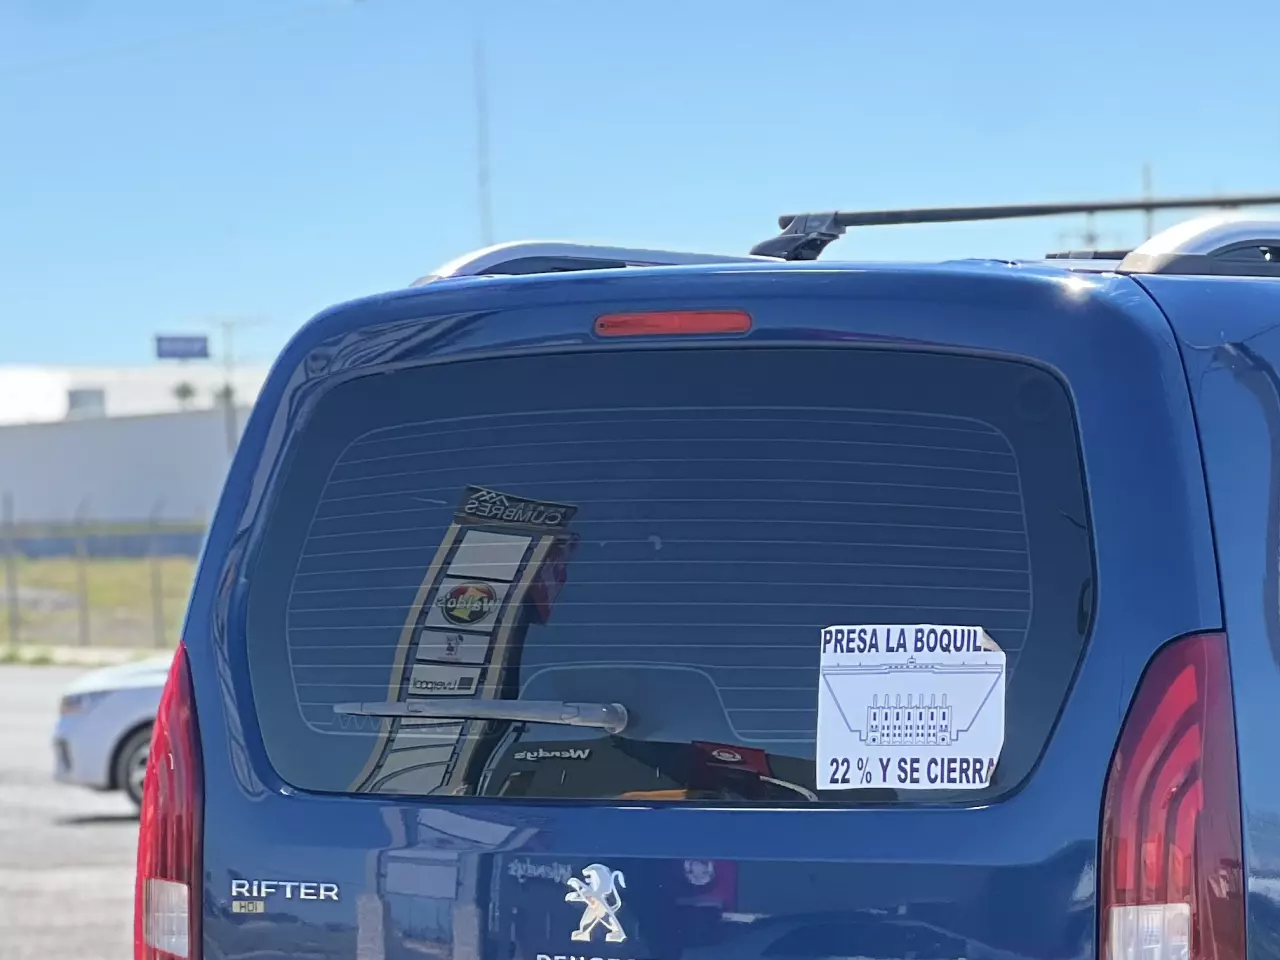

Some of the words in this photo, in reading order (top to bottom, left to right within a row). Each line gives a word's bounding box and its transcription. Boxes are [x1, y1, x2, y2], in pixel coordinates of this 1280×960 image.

[822, 628, 880, 654] PRESA
[885, 628, 908, 653] LA
[914, 628, 992, 654] BOQUIL
[829, 757, 850, 784] 22
[857, 757, 872, 784] %
[878, 757, 891, 783] Y
[897, 757, 920, 784] SE
[231, 879, 339, 900] RIFTER
